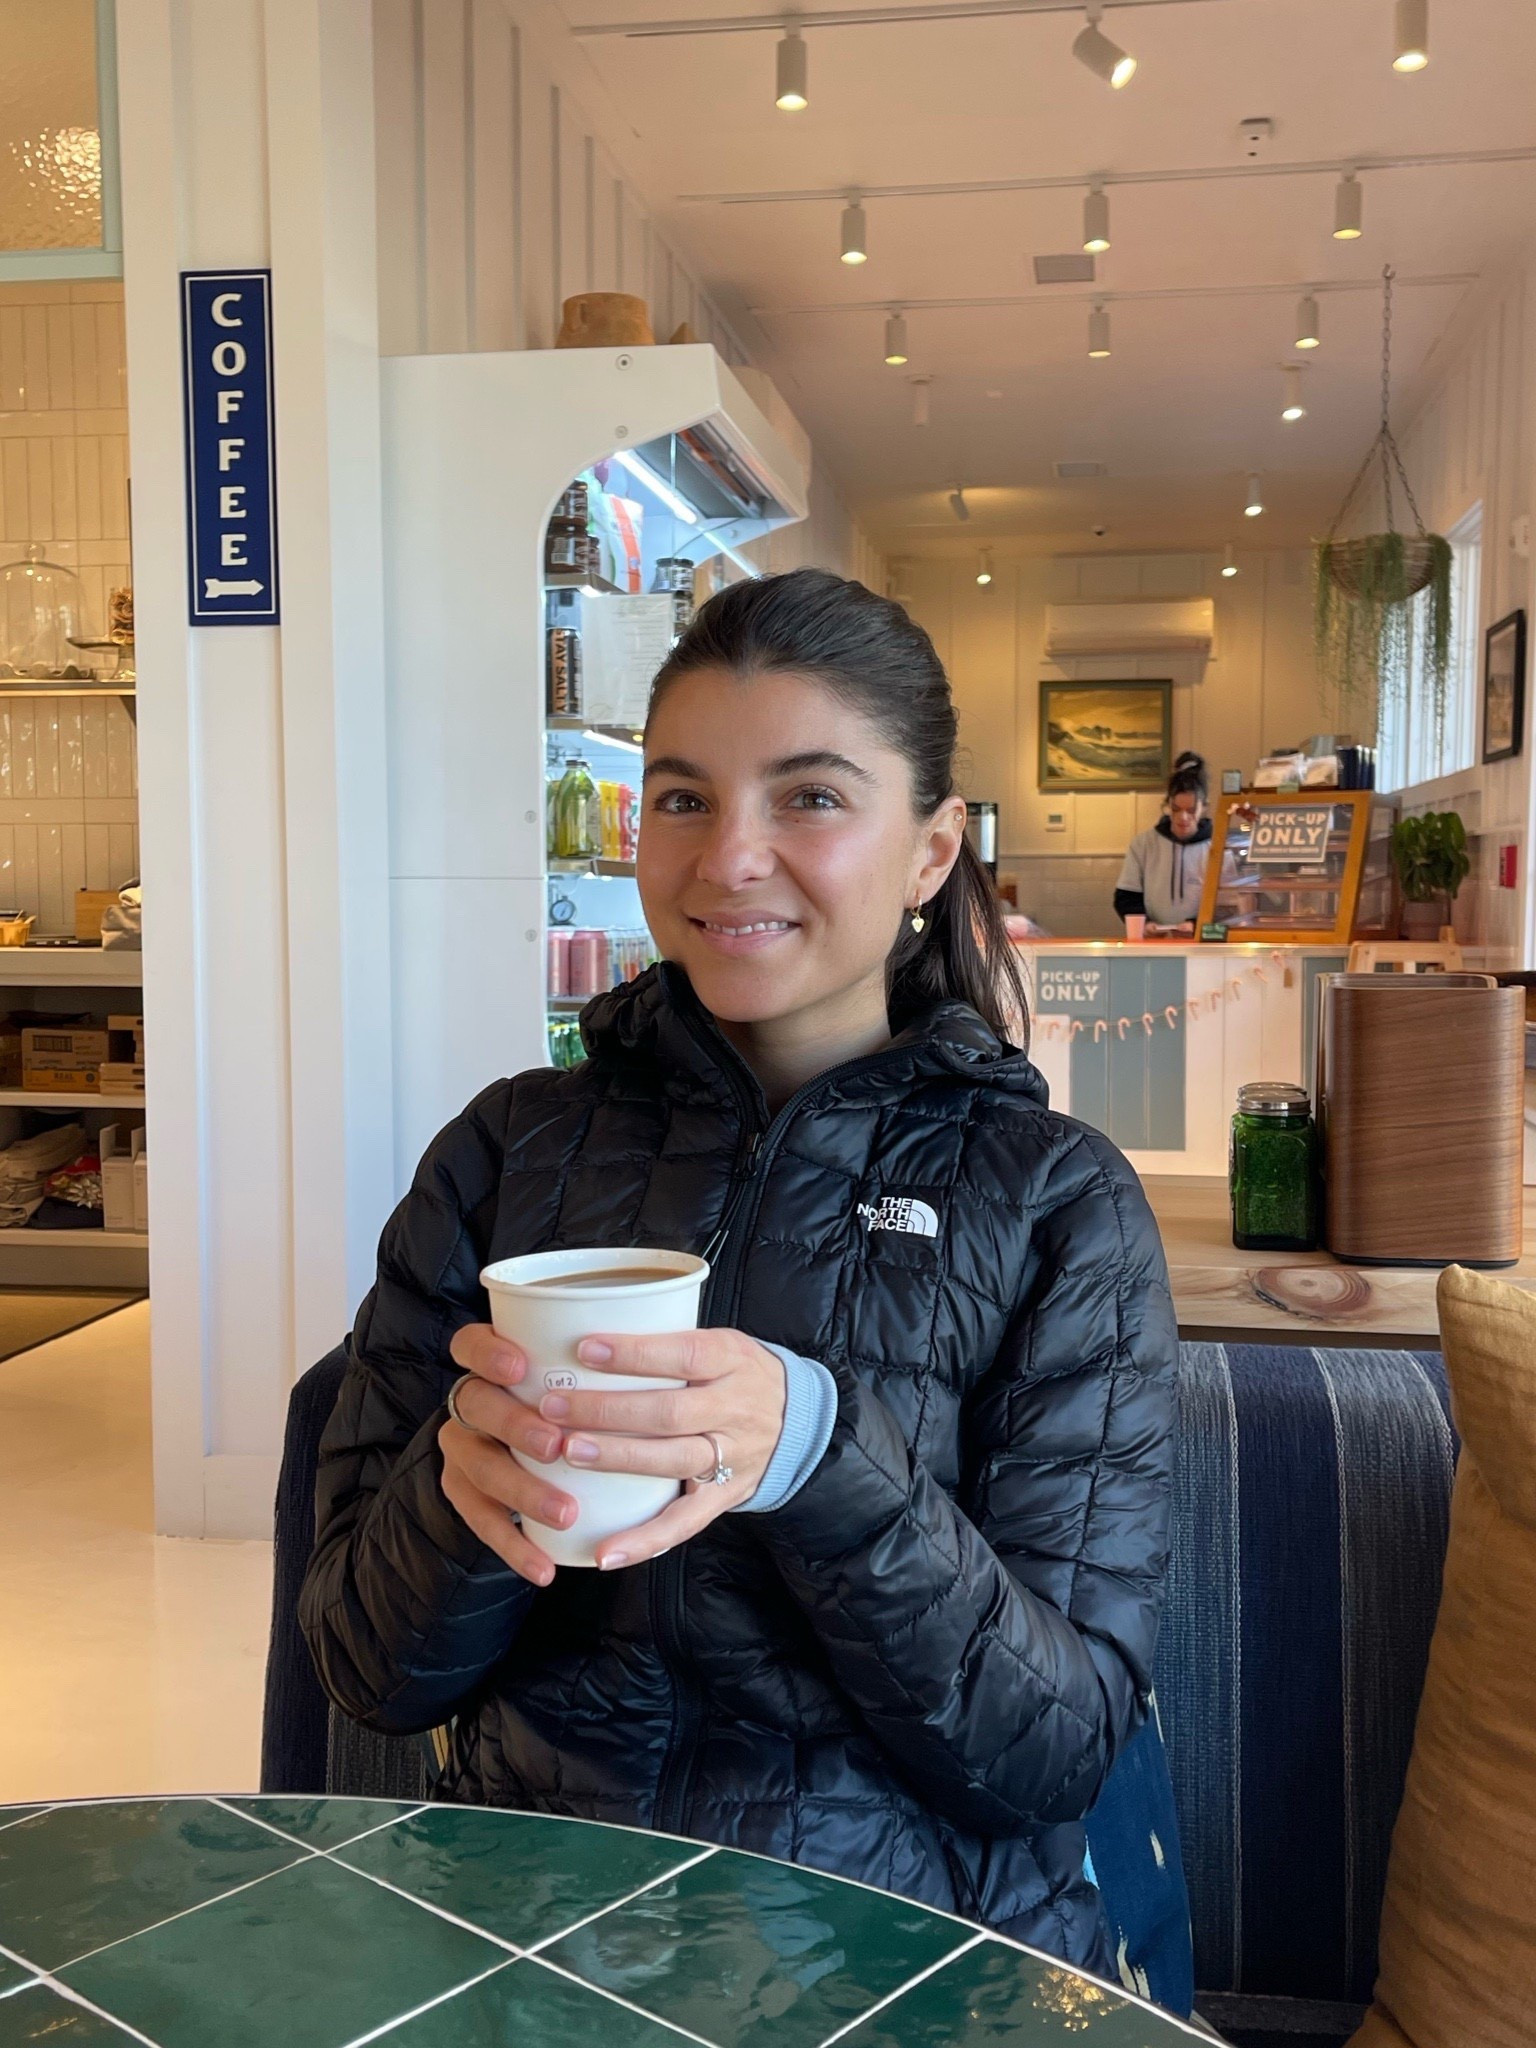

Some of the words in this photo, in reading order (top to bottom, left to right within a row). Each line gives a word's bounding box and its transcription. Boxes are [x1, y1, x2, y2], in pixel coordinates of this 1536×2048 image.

[211, 292, 248, 567] COFFEE
[555, 666, 567, 712] SALTY
[1259, 812, 1327, 826] PICK-UP
[1256, 827, 1323, 846] ONLY
[1041, 970, 1101, 983] PICK-UP
[1041, 984, 1099, 1002] ONLY
[881, 1196, 912, 1209] THE
[857, 1203, 909, 1220] NORTH
[867, 1218, 908, 1232] FACE
[555, 1377, 565, 1387] of
[567, 1377, 573, 1386] 2
